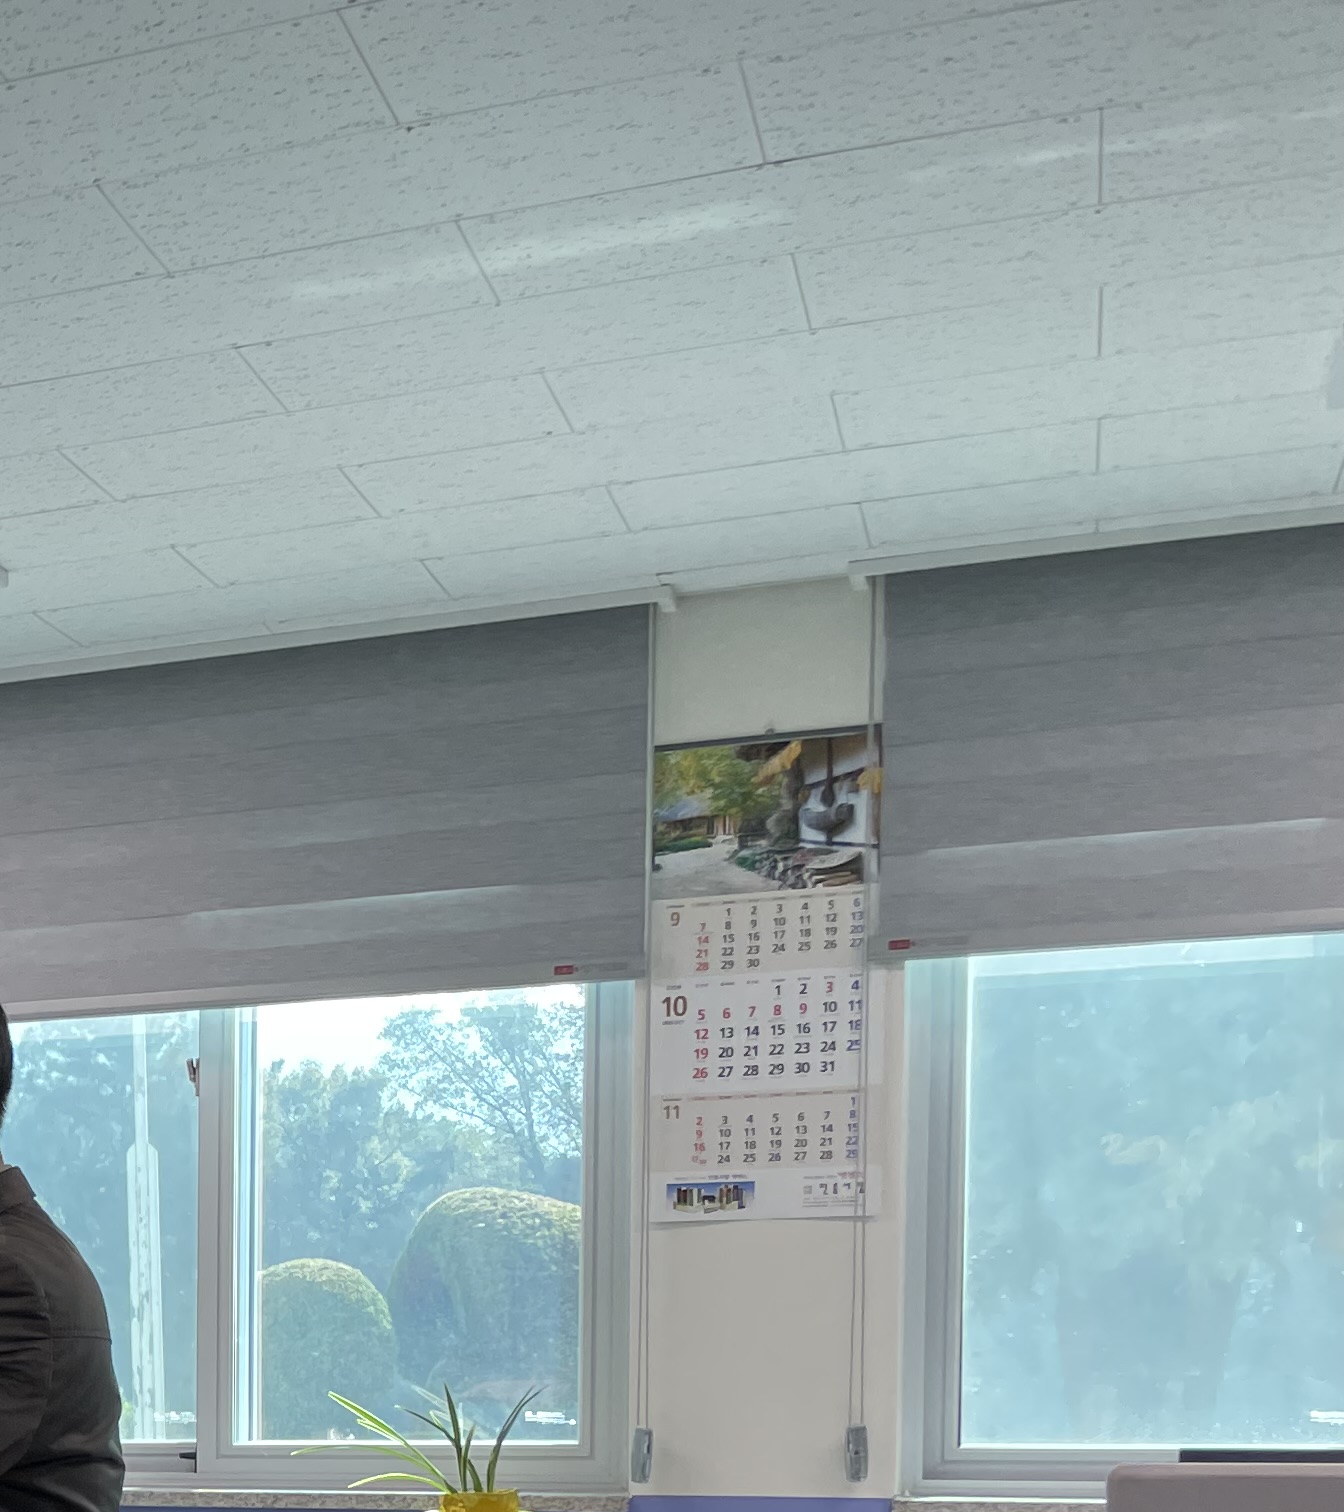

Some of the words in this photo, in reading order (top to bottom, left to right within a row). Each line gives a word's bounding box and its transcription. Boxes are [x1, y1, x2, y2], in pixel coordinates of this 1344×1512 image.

[726, 908, 731, 917] 1
[751, 906, 757, 915] 2
[776, 904, 782, 913] 3
[801, 902, 808, 911] 4
[828, 900, 834, 909] 5
[853, 898, 860, 908] 6
[670, 912, 680, 926] 9
[700, 923, 706, 932] 7
[725, 921, 731, 930] 8
[750, 919, 757, 928] 9
[773, 917, 785, 926] 10
[799, 915, 810, 925] 11
[826, 913, 837, 922] 12
[852, 911, 863, 920] 13
[697, 936, 709, 944] 14
[723, 934, 734, 943] 15
[748, 932, 760, 942] 16
[774, 930, 785, 939] 17
[799, 928, 811, 937] 18
[825, 927, 837, 935] 19
[850, 924, 863, 933] 20
[696, 949, 708, 958] 21
[721, 947, 734, 956] 22
[747, 945, 760, 955] 23
[771, 944, 785, 953] 24
[798, 942, 811, 951] 25
[824, 940, 837, 949] 26
[850, 938, 863, 947] 27
[696, 962, 709, 971] 28
[721, 960, 734, 969] 29
[747, 958, 759, 968] 30
[775, 985, 781, 995] 1
[799, 983, 807, 994] 2
[826, 981, 833, 993] 3
[851, 980, 859, 990] 4
[661, 995, 687, 1017] 10
[698, 1009, 705, 1020] 5
[722, 1007, 730, 1019] 6
[748, 1006, 756, 1017] 7
[773, 1004, 781, 1015] 8
[799, 1003, 807, 1014] 9
[823, 1001, 837, 1013] 10
[848, 1000, 862, 1011] 11
[695, 1029, 708, 1039] 12
[720, 1027, 733, 1038] 13
[744, 1026, 759, 1037] 14
[771, 1024, 785, 1035] 15
[796, 1022, 810, 1034] 16
[822, 1021, 837, 1032] 17
[848, 1019, 861, 1030] 18
[694, 1048, 708, 1059] 19
[719, 1047, 733, 1058] 20
[743, 1045, 758, 1056] 21
[769, 1044, 784, 1055] 22
[795, 1042, 810, 1054] 23
[820, 1041, 836, 1052] 24
[693, 1068, 708, 1079] 26
[718, 1066, 733, 1077] 27
[743, 1065, 759, 1076] 28
[769, 1063, 784, 1075] 29
[795, 1062, 810, 1073] 30
[820, 1060, 835, 1072] 31
[851, 1097, 855, 1106] 1
[663, 1105, 679, 1119] 11
[696, 1116, 703, 1126] 2
[721, 1116, 728, 1125] 3
[746, 1115, 753, 1123] 4
[772, 1113, 779, 1122] 5
[798, 1112, 804, 1121] 6
[824, 1111, 830, 1120] 7
[850, 1110, 856, 1118] 8
[696, 1129, 702, 1139] 9
[719, 1128, 731, 1138] 10
[744, 1127, 755, 1136] 11
[770, 1127, 782, 1136] 12
[795, 1125, 807, 1134] 13
[820, 1124, 833, 1133] 14
[694, 1142, 705, 1152] 16
[719, 1142, 730, 1151] 17
[744, 1141, 756, 1150] 18
[770, 1140, 781, 1149] 19
[794, 1138, 807, 1148] 20
[820, 1137, 832, 1146] 21
[718, 1155, 730, 1164] 24
[743, 1153, 756, 1163] 25
[768, 1153, 781, 1162] 26
[794, 1151, 807, 1161] 27
[820, 1150, 832, 1159] 28
